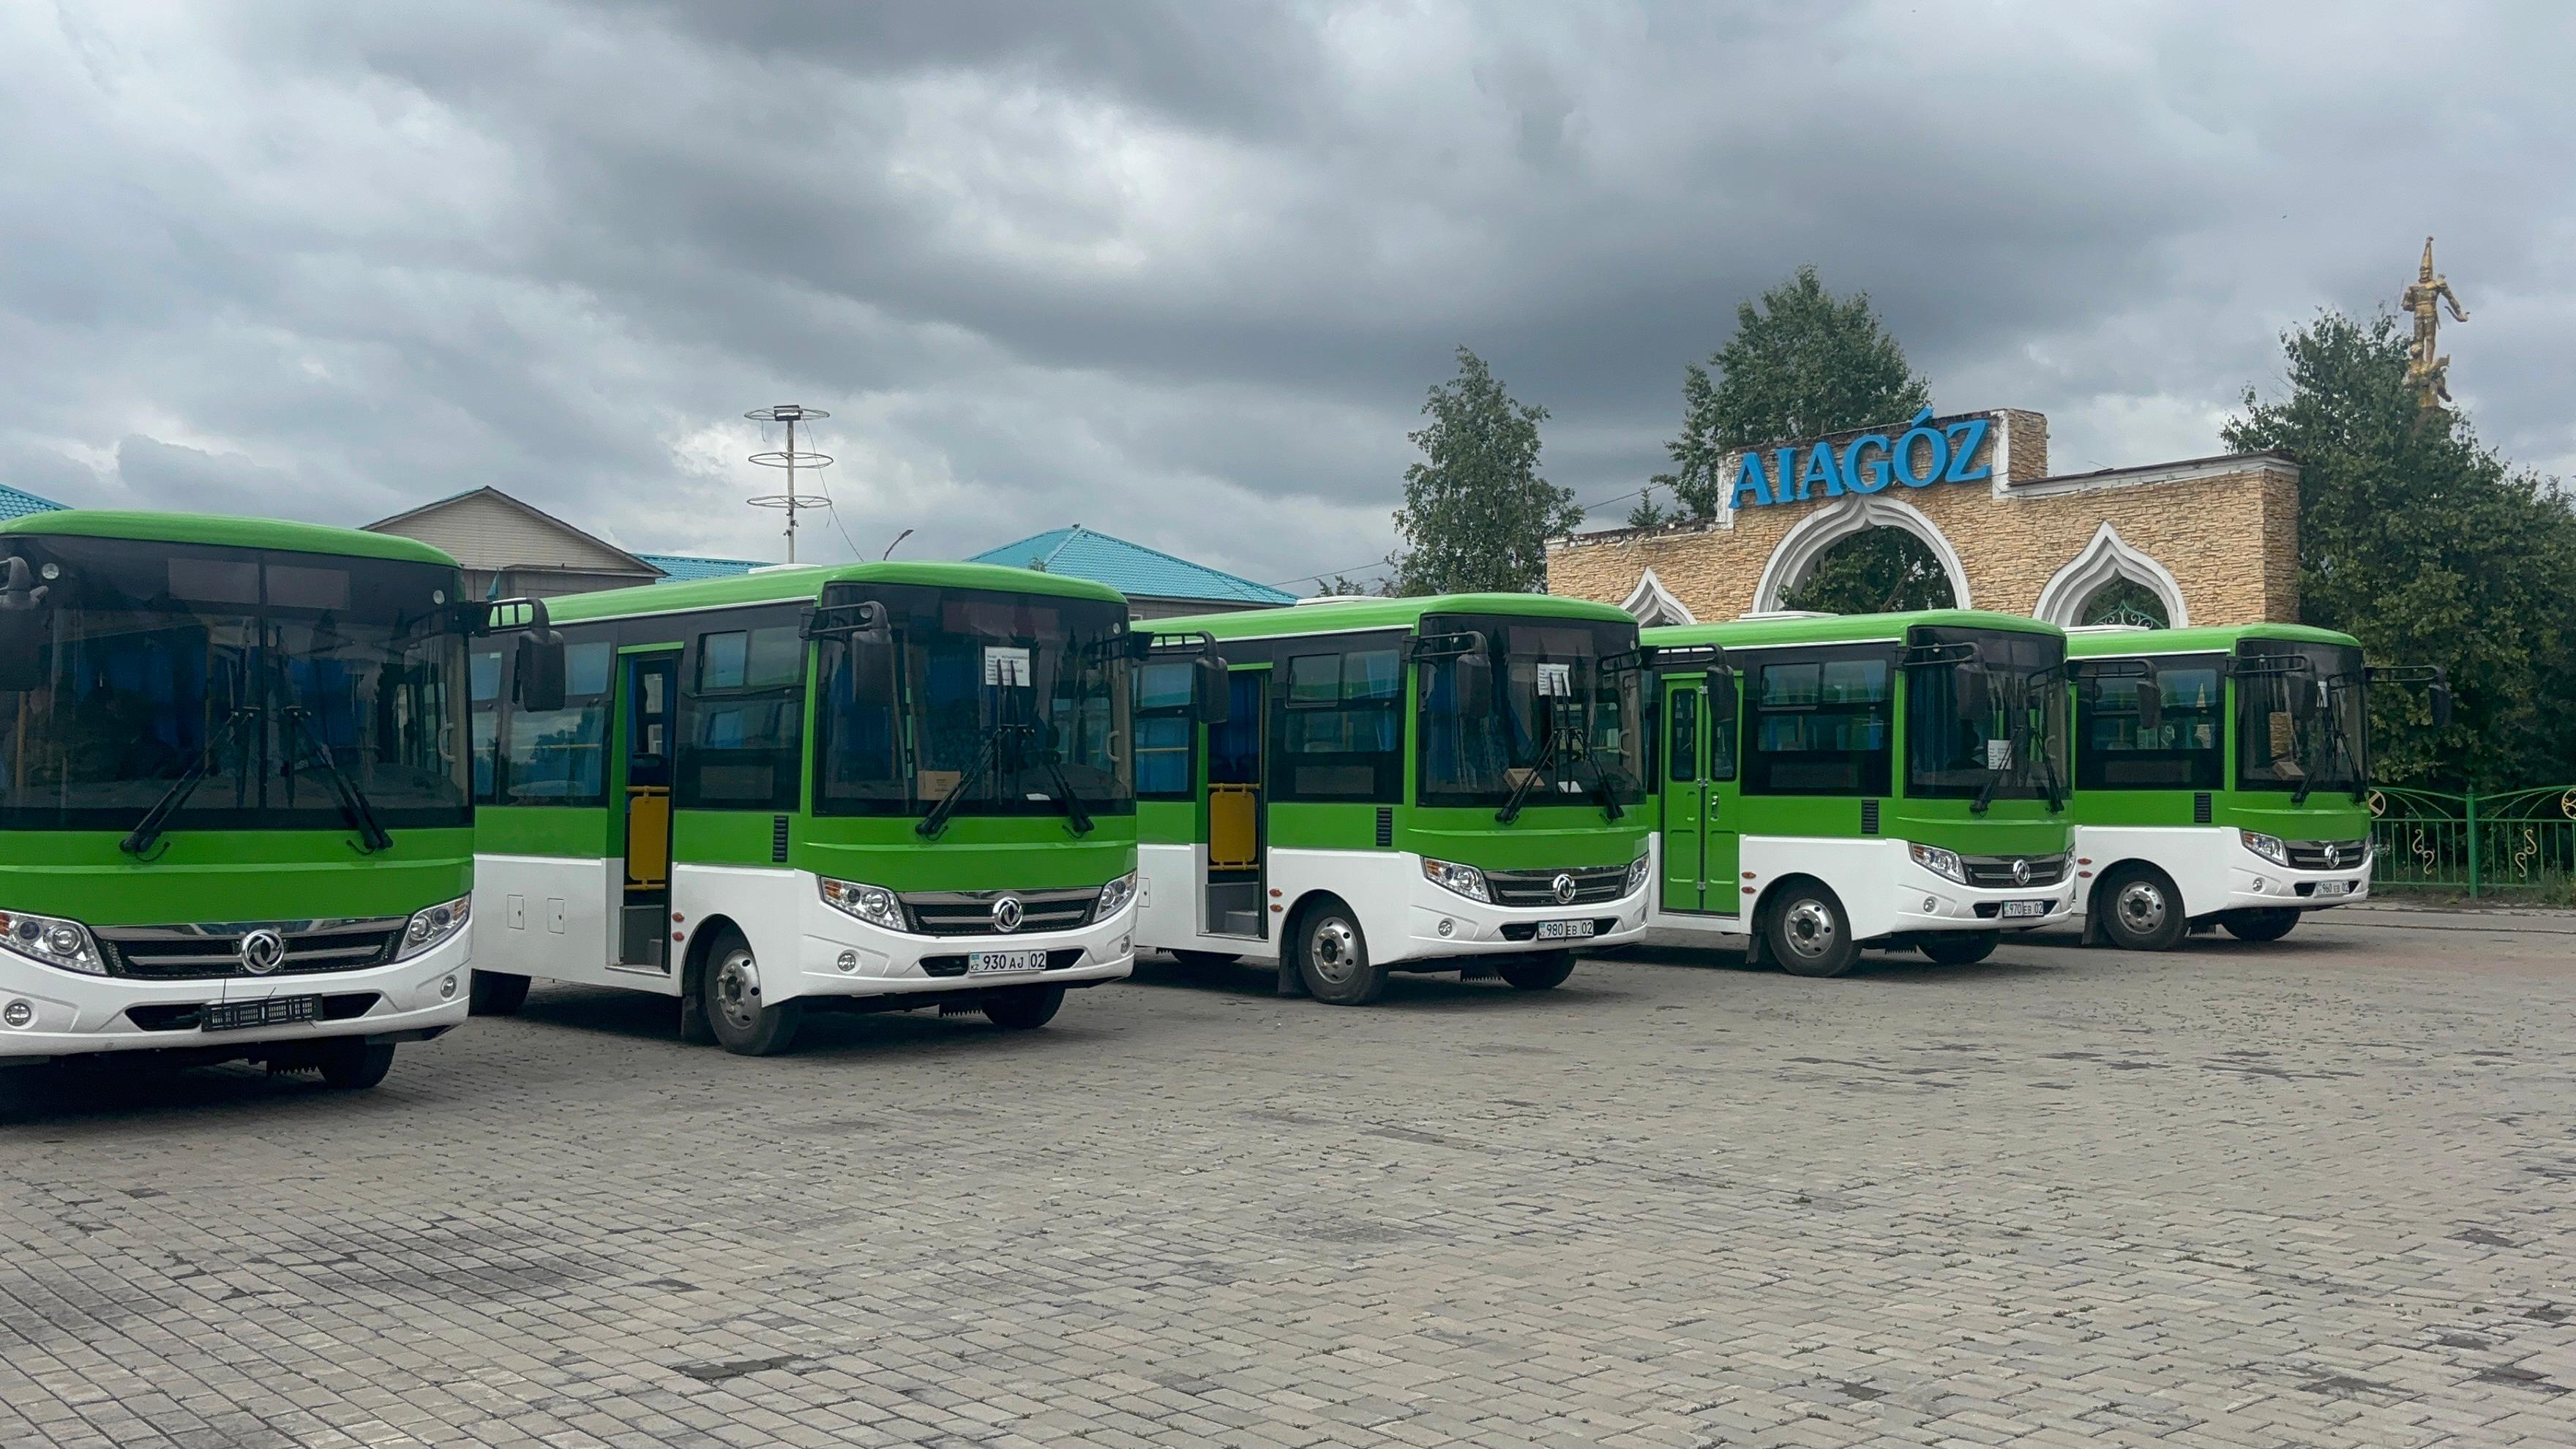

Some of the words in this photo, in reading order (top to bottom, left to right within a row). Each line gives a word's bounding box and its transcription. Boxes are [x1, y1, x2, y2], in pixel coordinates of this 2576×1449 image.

[1728, 405, 1992, 509] AIAGÓZ
[2009, 904, 2022, 914] 970
[2034, 902, 2043, 914] 02
[1546, 923, 1564, 937] 980
[1566, 925, 1578, 935] EB
[1581, 921, 1592, 935] 02
[983, 954, 1007, 970] 930
[1009, 956, 1024, 970] AJ
[1030, 953, 1045, 968] 02
